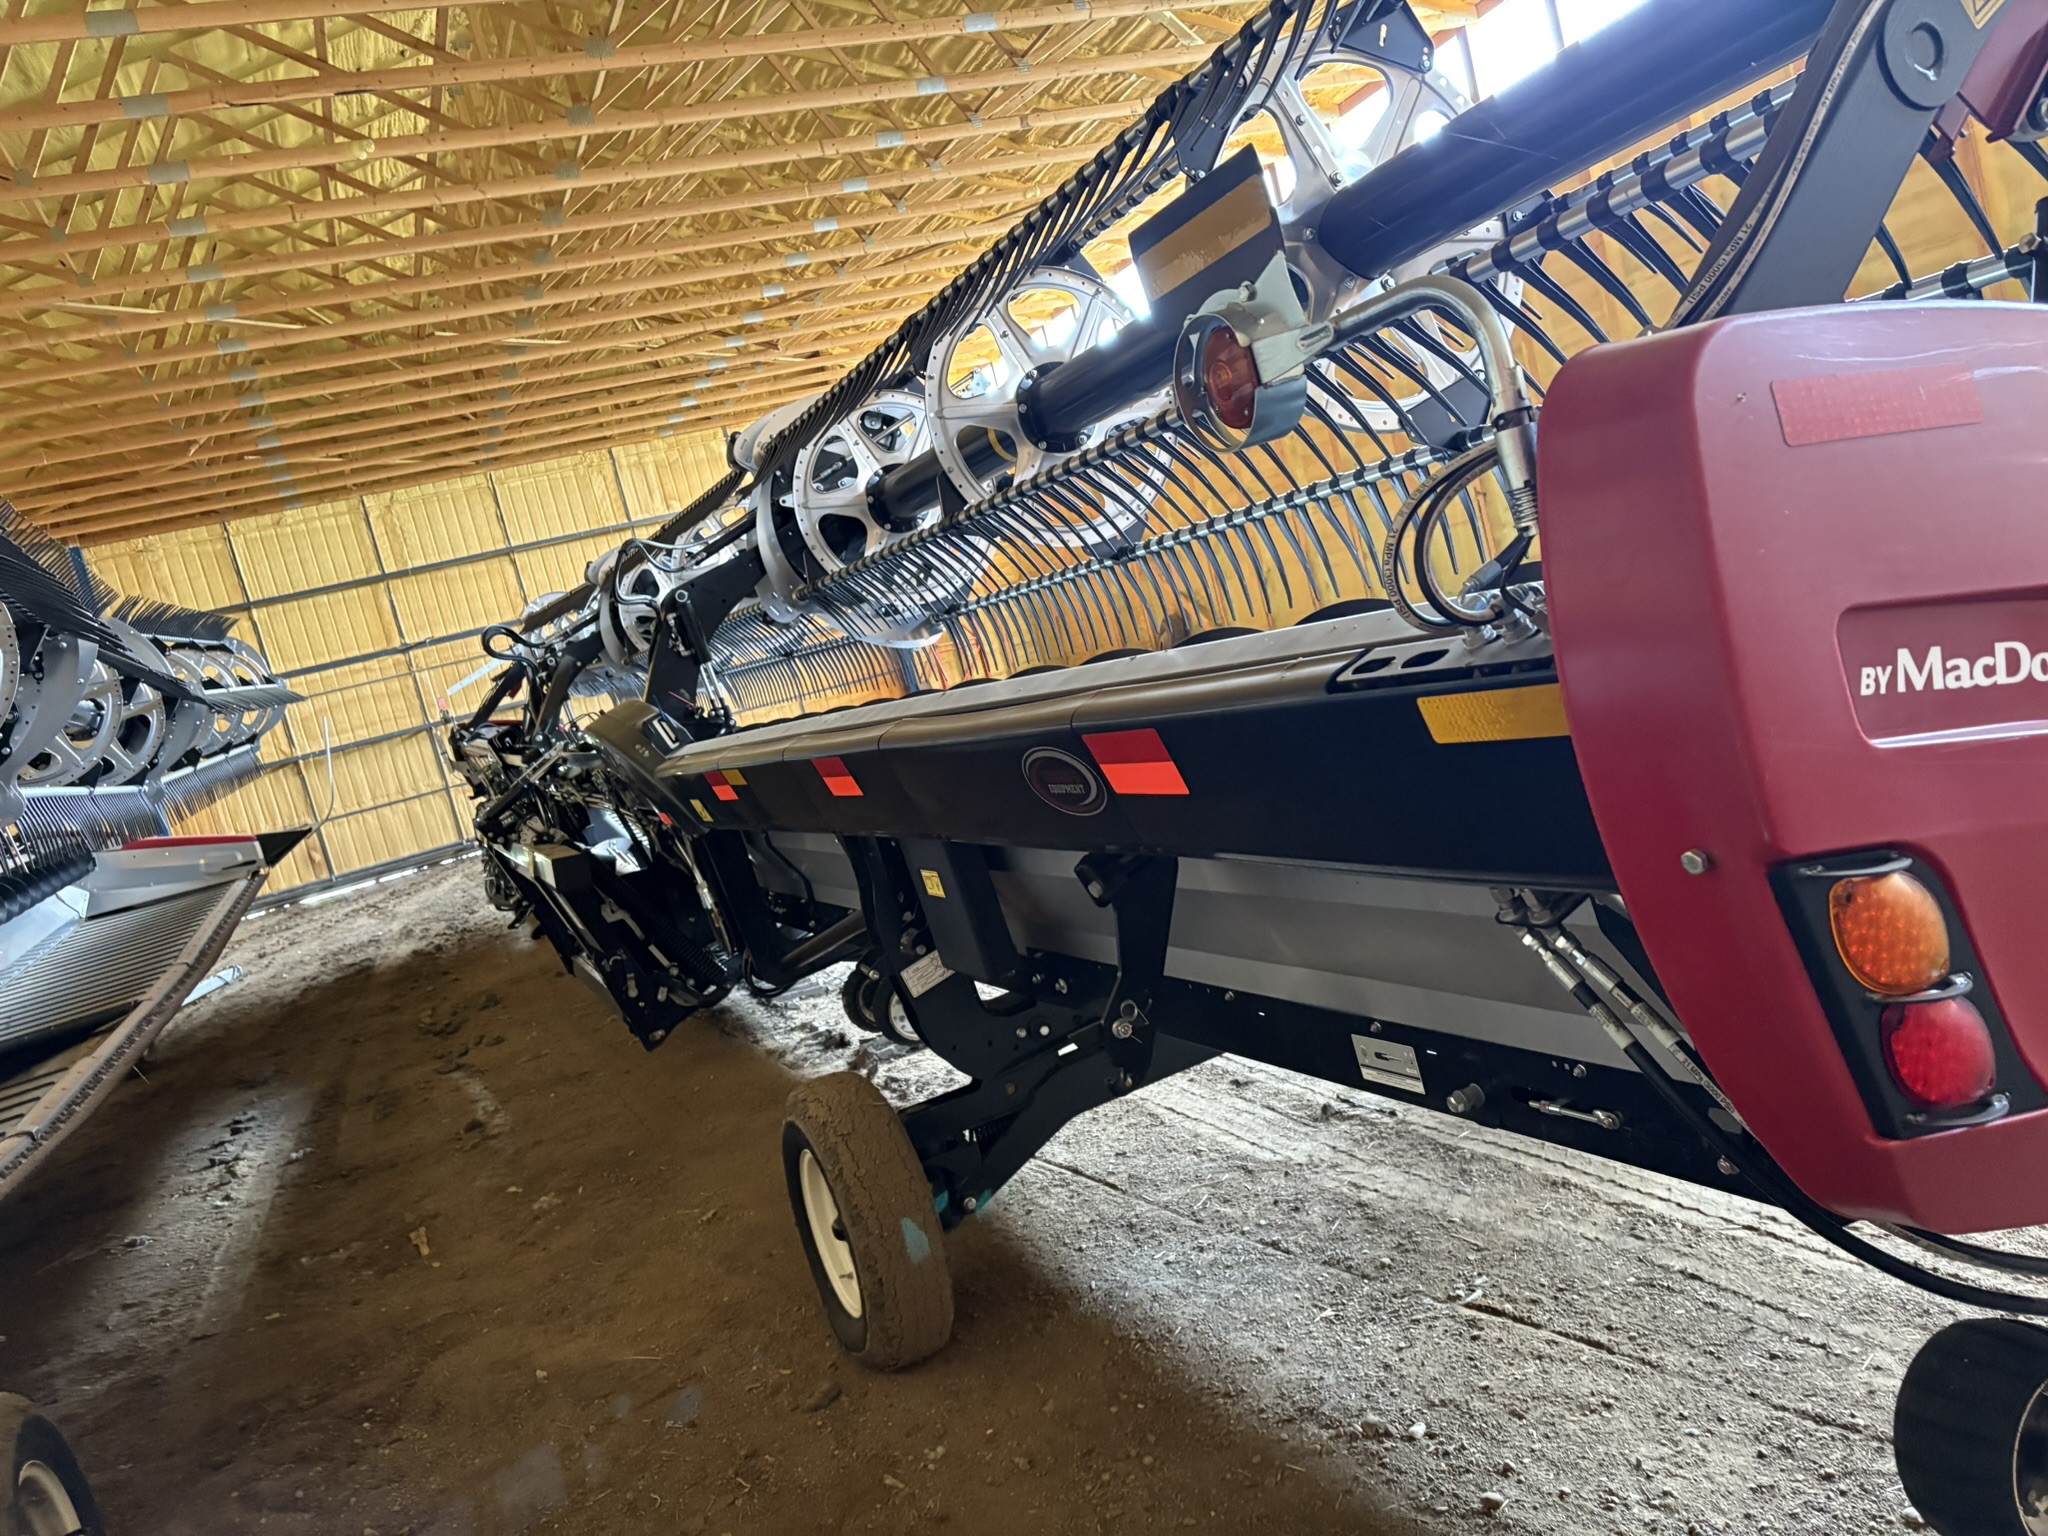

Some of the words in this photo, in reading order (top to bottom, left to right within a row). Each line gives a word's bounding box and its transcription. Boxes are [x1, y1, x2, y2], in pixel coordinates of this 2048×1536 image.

[1740, 223, 1753, 236] 21
[1388, 528, 1398, 540] 21
[1384, 544, 1394, 566] MPa
[1384, 568, 1398, 598] (3000
[1394, 598, 1411, 620] PSI)
[1860, 664, 1893, 696] BY
[1896, 641, 2048, 694] MacDo
[1048, 784, 1086, 794] EQUIPMENT
[1682, 1058, 1690, 1067] 21
